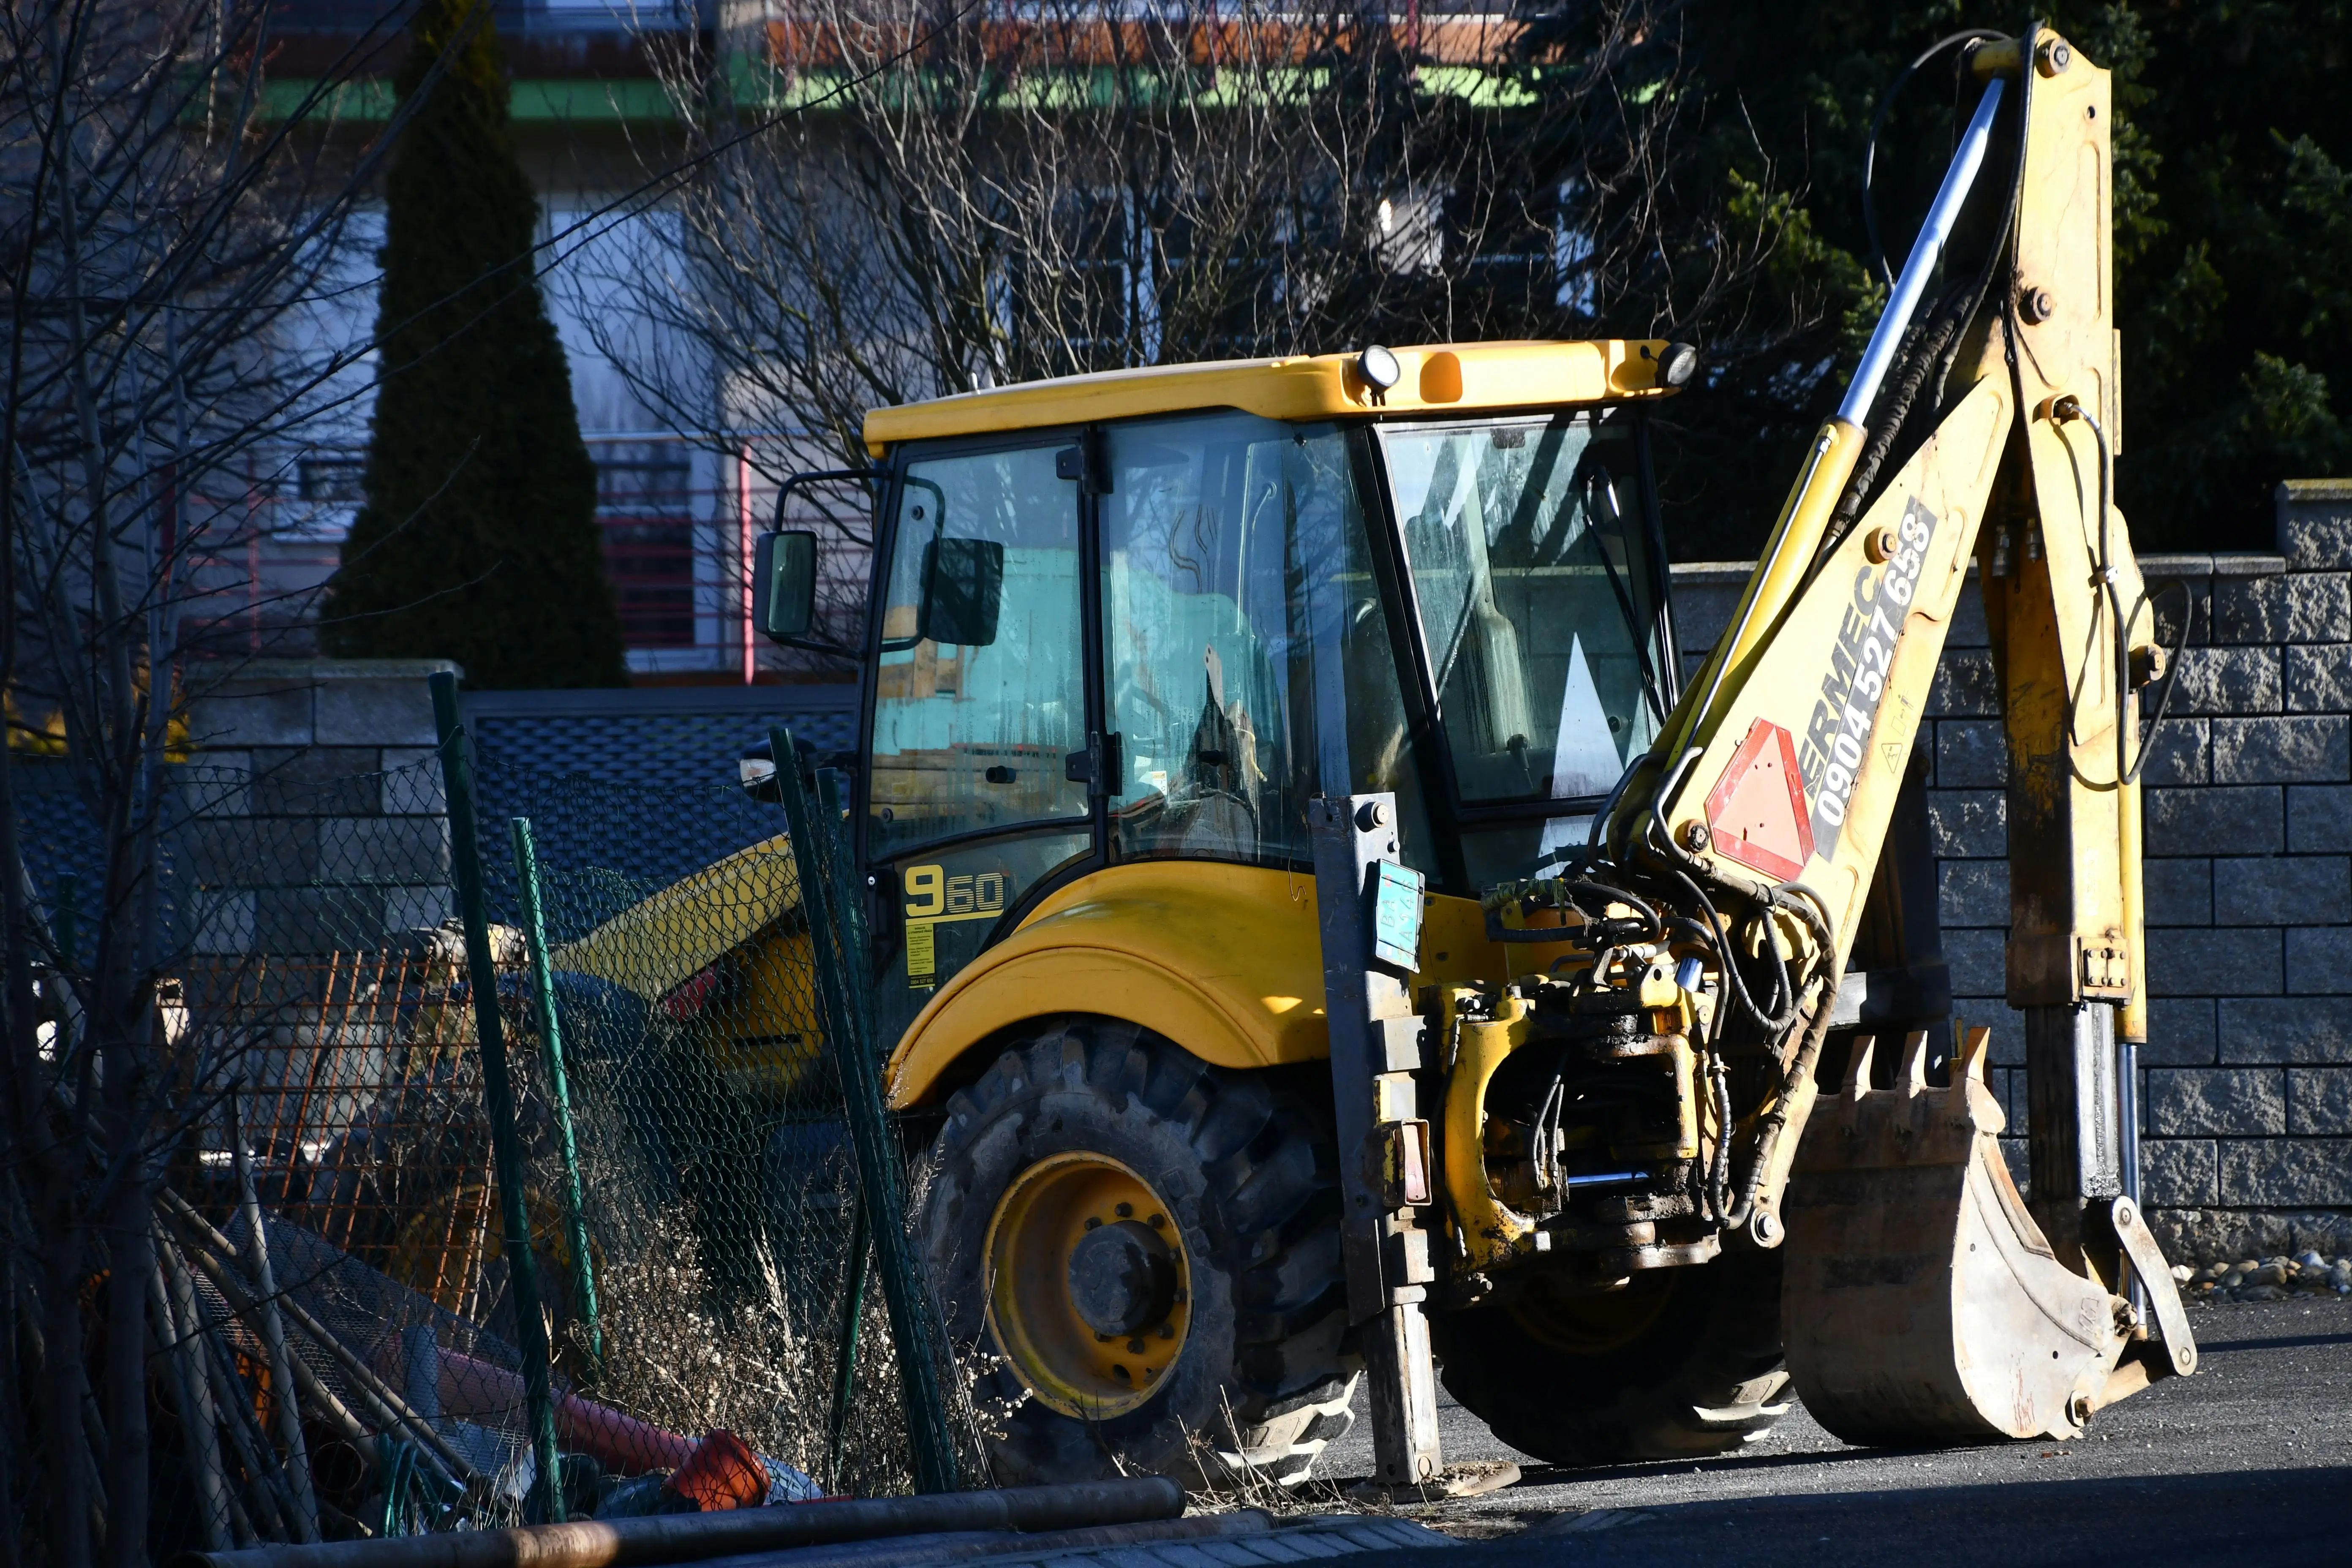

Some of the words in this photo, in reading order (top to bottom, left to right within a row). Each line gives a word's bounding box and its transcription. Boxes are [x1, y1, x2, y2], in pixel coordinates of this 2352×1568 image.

[1798, 565, 1881, 801] ERMEC
[1818, 703, 1871, 826] 0904
[1854, 605, 1896, 702] 527
[1885, 513, 1930, 606] 658
[905, 864, 1004, 917] 960
[1380, 900, 1395, 927] BA
